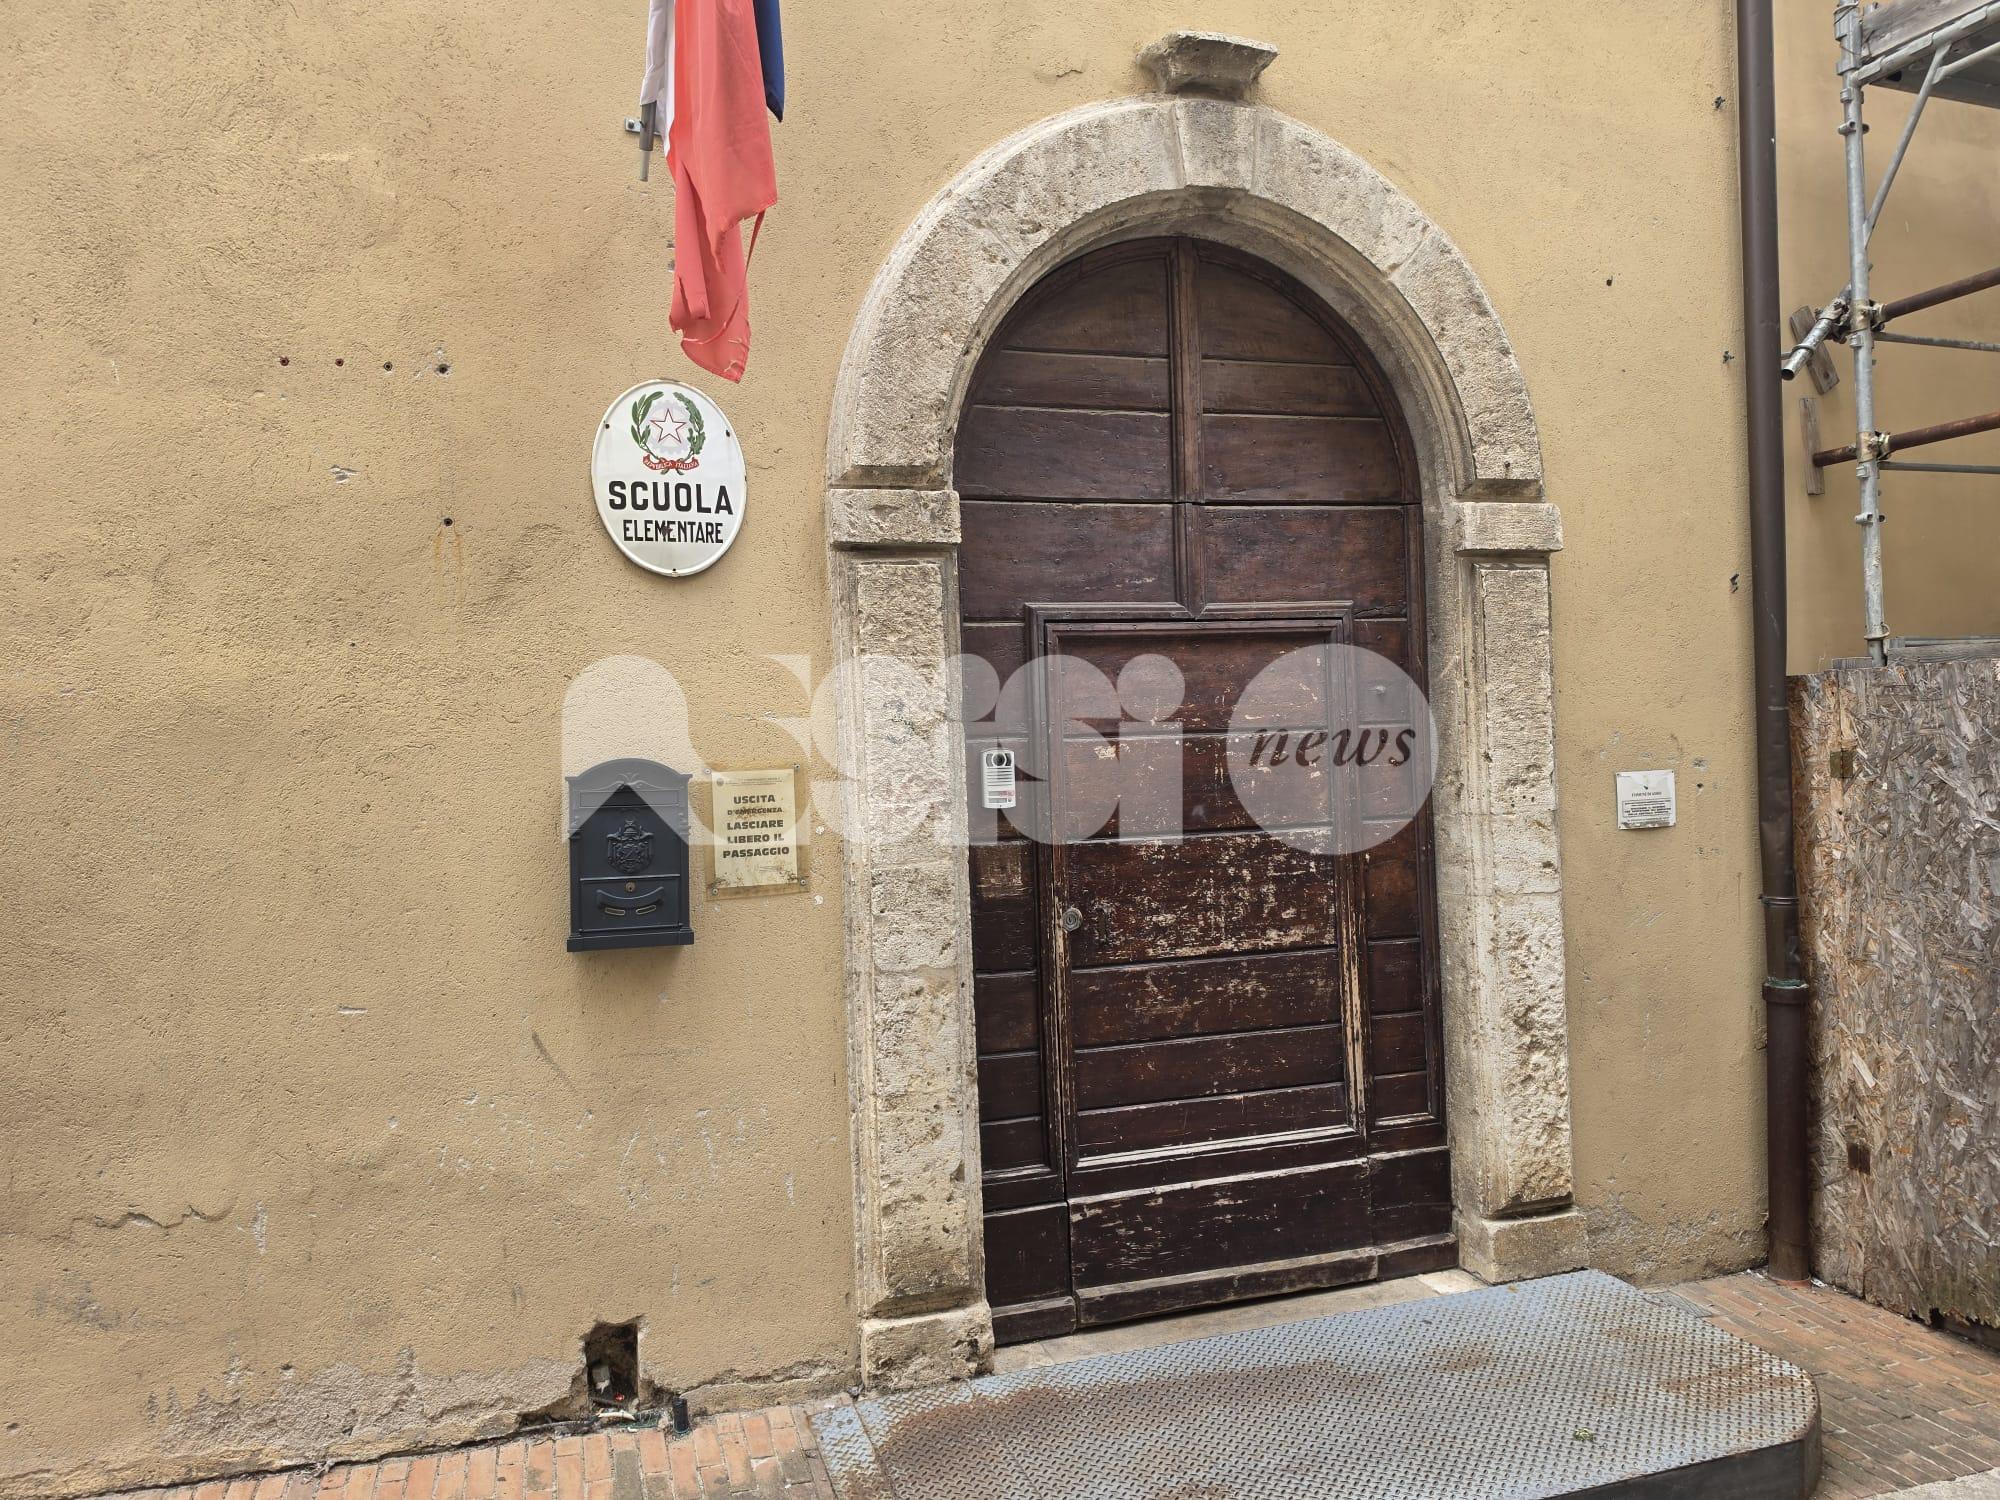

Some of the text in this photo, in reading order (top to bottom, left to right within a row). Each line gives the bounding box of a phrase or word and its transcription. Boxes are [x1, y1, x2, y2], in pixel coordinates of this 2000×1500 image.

[608, 480, 733, 515] SCUOLA
[623, 519, 723, 543] ELEMENTARE
[733, 795, 776, 805] USCITA
[727, 820, 784, 830] LASCIARE
[727, 833, 785, 844] LIBERO IL
[722, 846, 790, 859] PASSAGGIO
